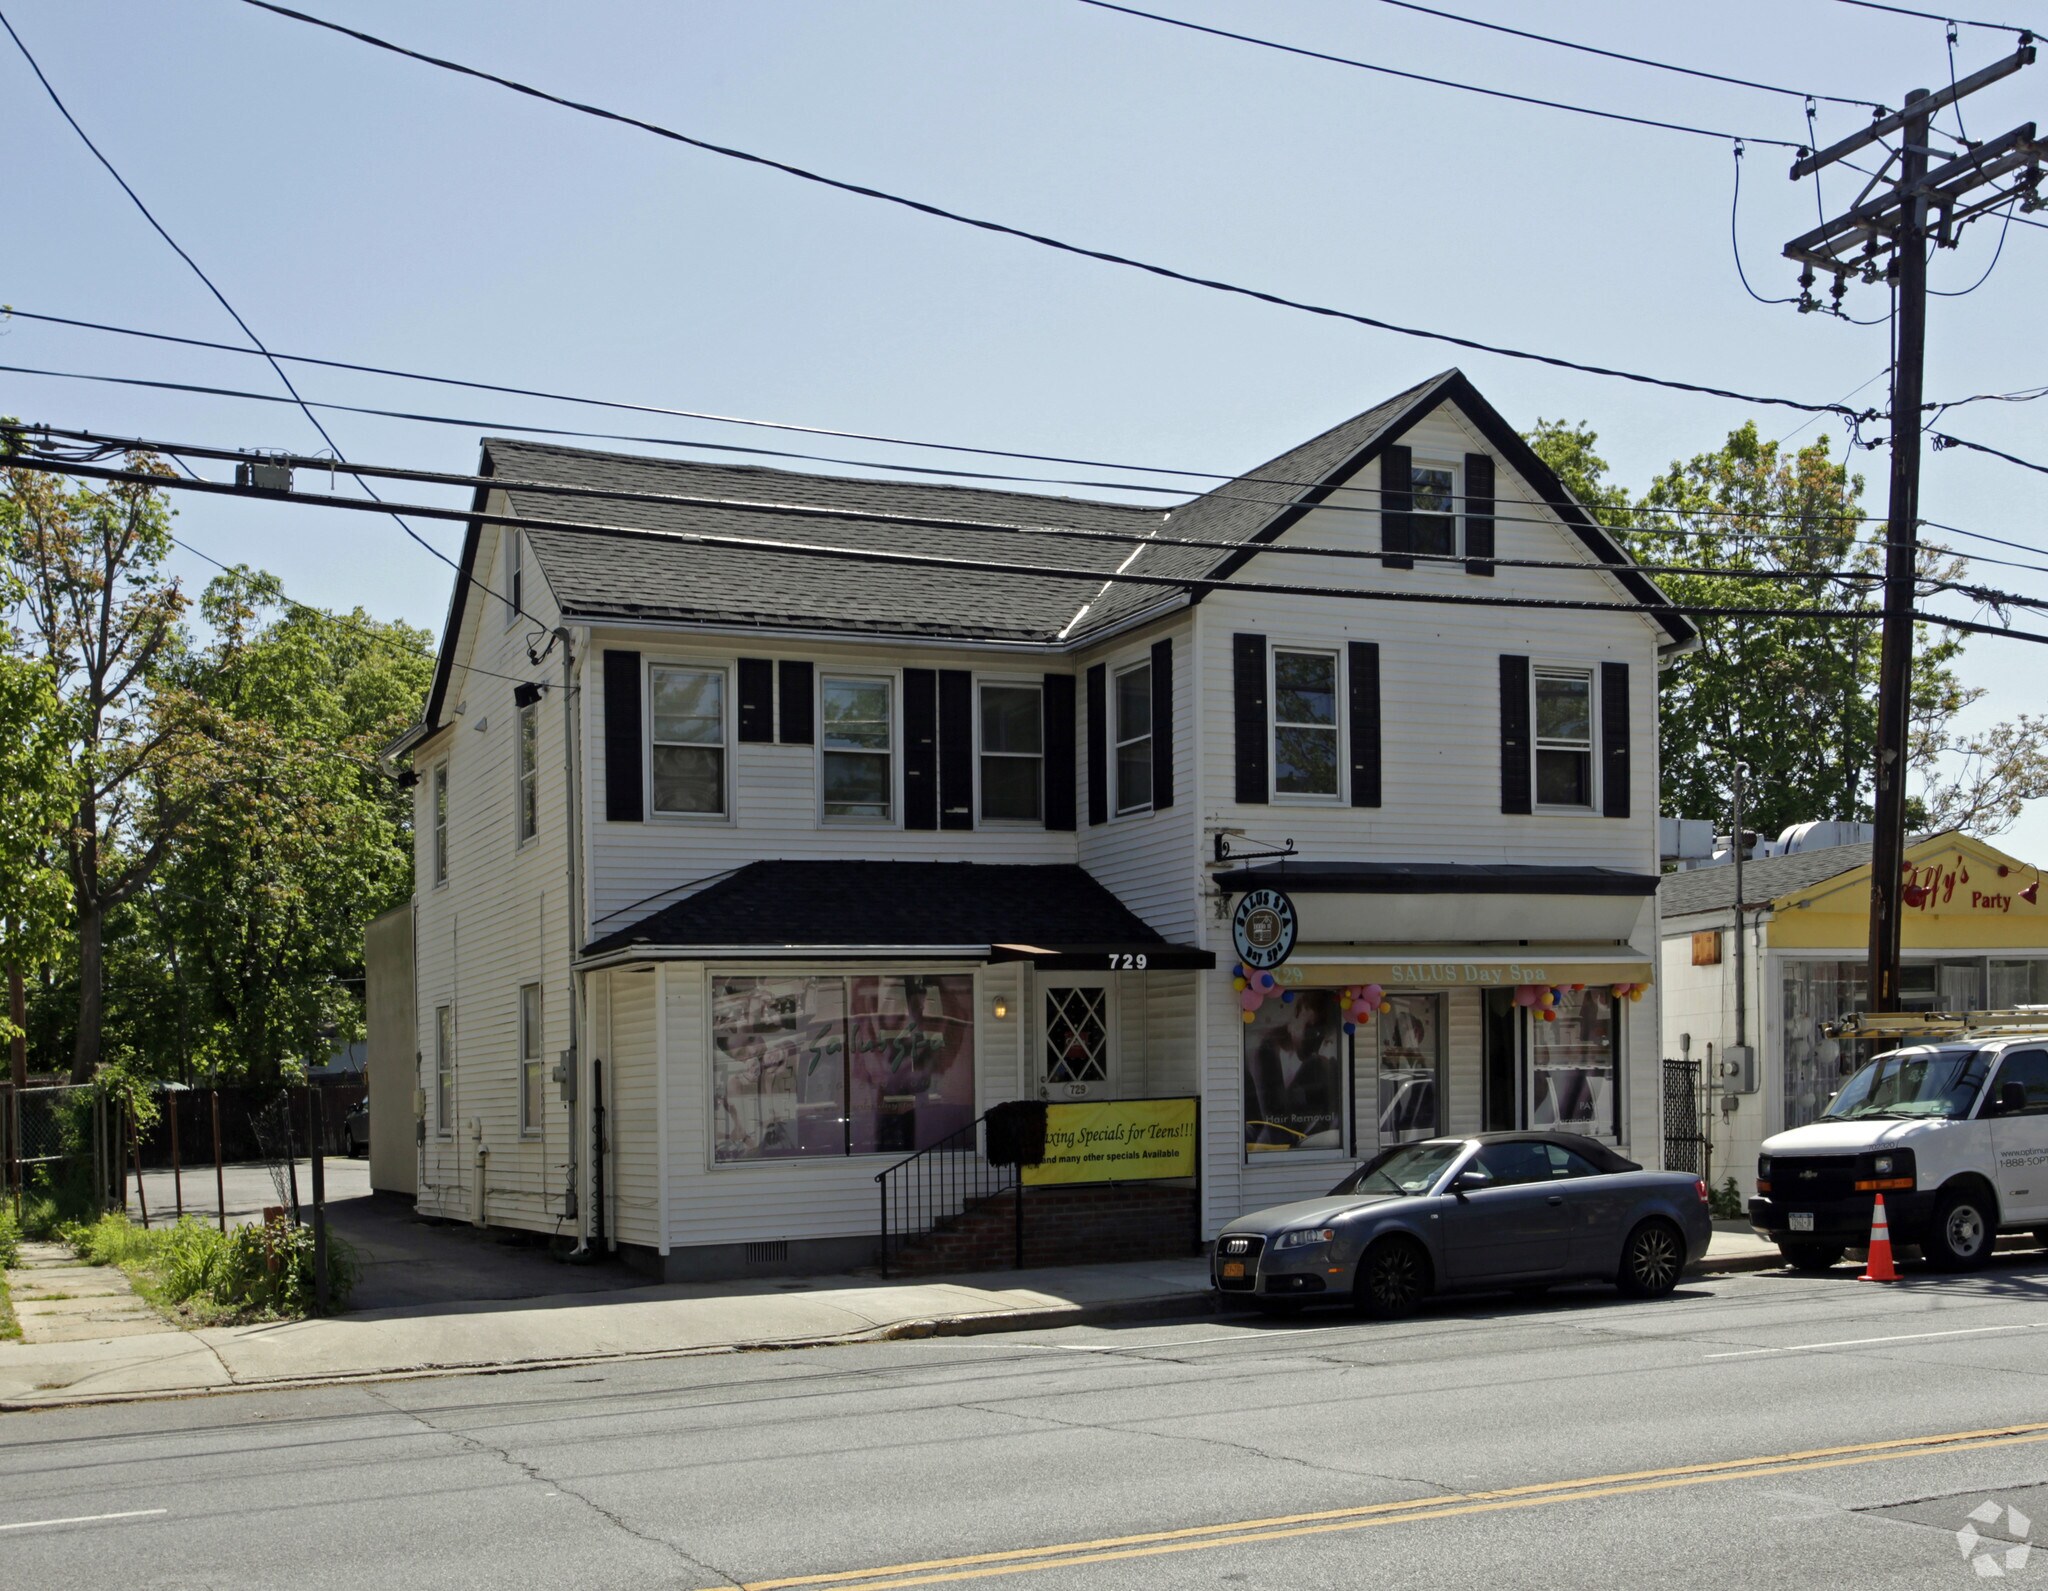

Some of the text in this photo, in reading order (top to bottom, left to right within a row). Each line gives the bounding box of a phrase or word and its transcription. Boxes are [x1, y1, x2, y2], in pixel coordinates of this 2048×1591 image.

[1237, 891, 1292, 929] SALUS SPA
[1972, 891, 2011, 913] Party
[1108, 953, 1147, 970] 729
[1245, 946, 1263, 965] Day
[1391, 965, 1458, 982] SALUS
[1464, 965, 1502, 983] Day
[1510, 964, 1547, 985] Spa
[1070, 1084, 1087, 1095] 729
[1265, 1111, 1335, 1124] Hair Removal
[1077, 1123, 1125, 1147] Specials
[1124, 1123, 1146, 1145] for
[1147, 1122, 1194, 1140] Teens!!!
[1058, 1155, 1081, 1165] many
[1083, 1152, 1104, 1162] other
[1106, 1150, 1140, 1162] specials
[1142, 1149, 1180, 1159] Available
